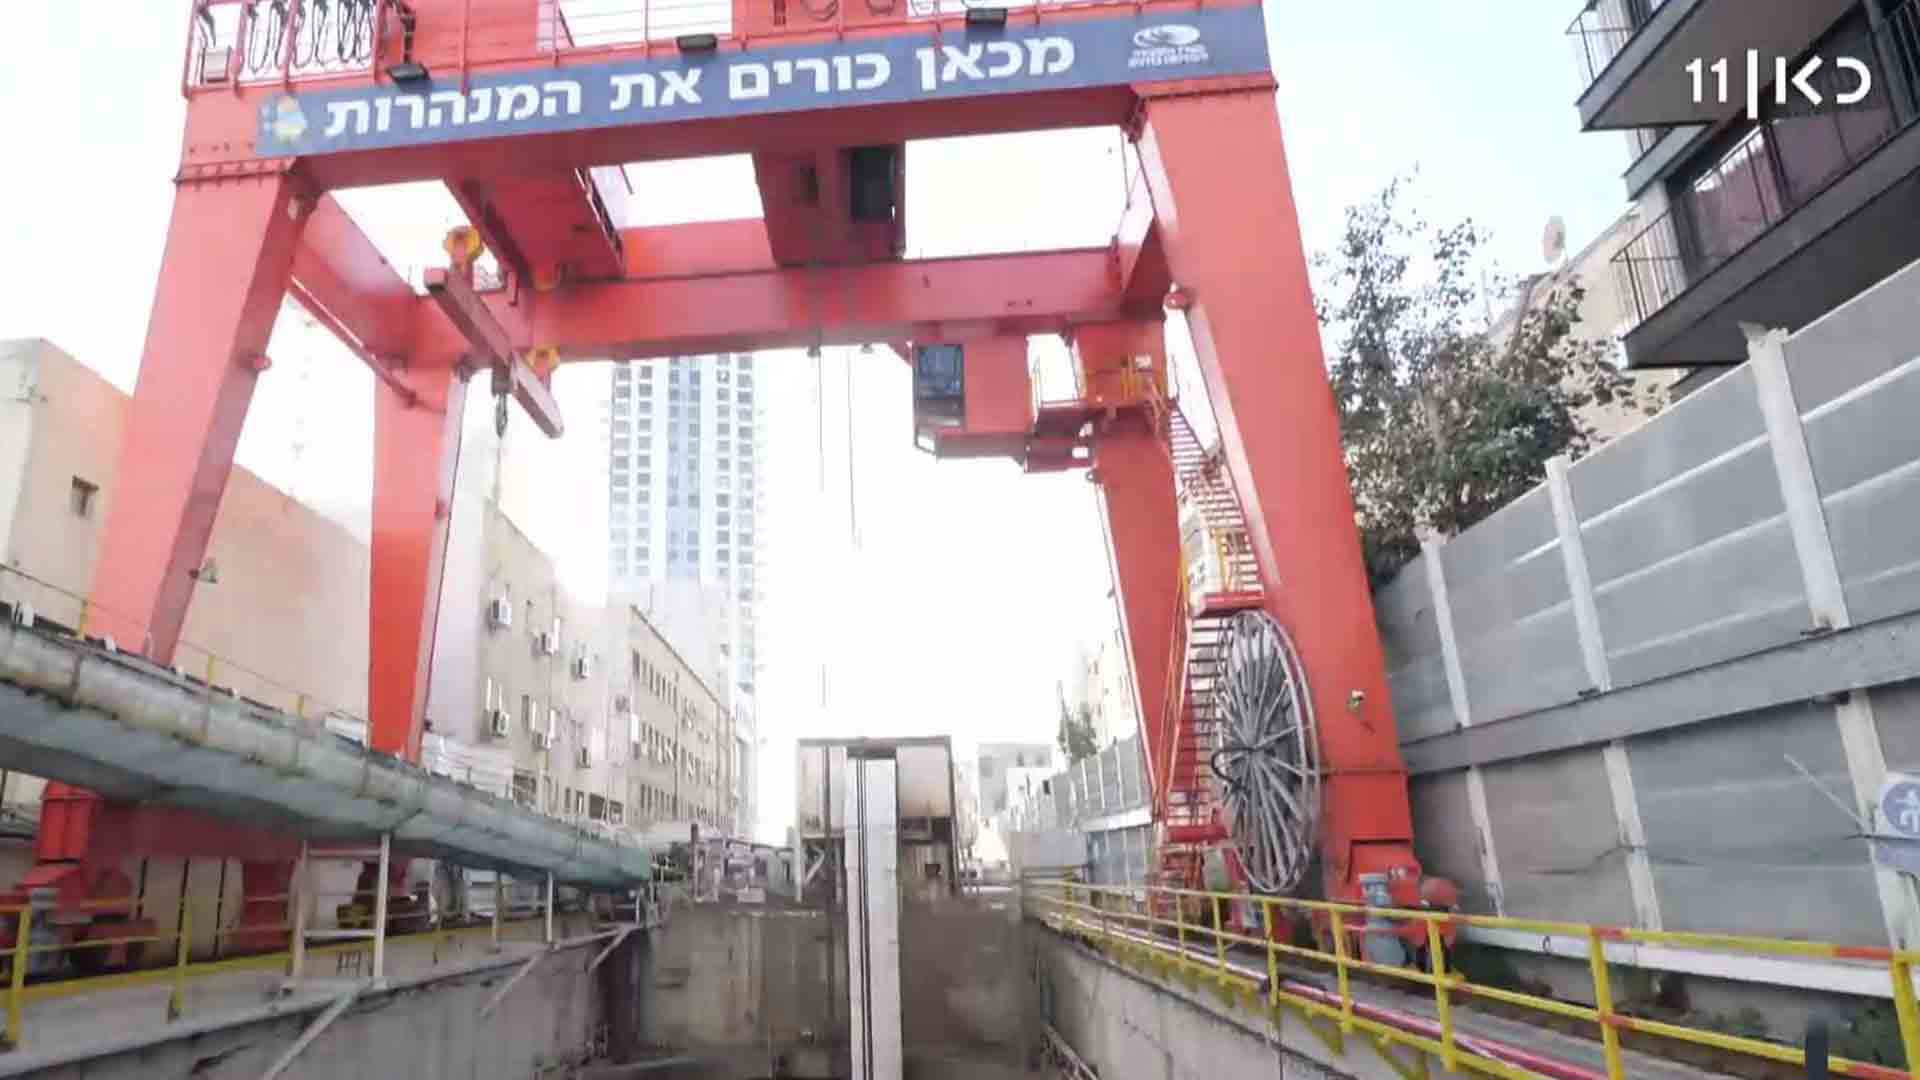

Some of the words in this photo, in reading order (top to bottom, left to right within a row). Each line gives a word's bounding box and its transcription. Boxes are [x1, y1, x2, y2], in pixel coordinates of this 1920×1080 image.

[609, 67, 703, 108] את
[729, 53, 891, 99] כורים
[916, 37, 1075, 91] מכאן
[325, 80, 582, 137] המנהרות
